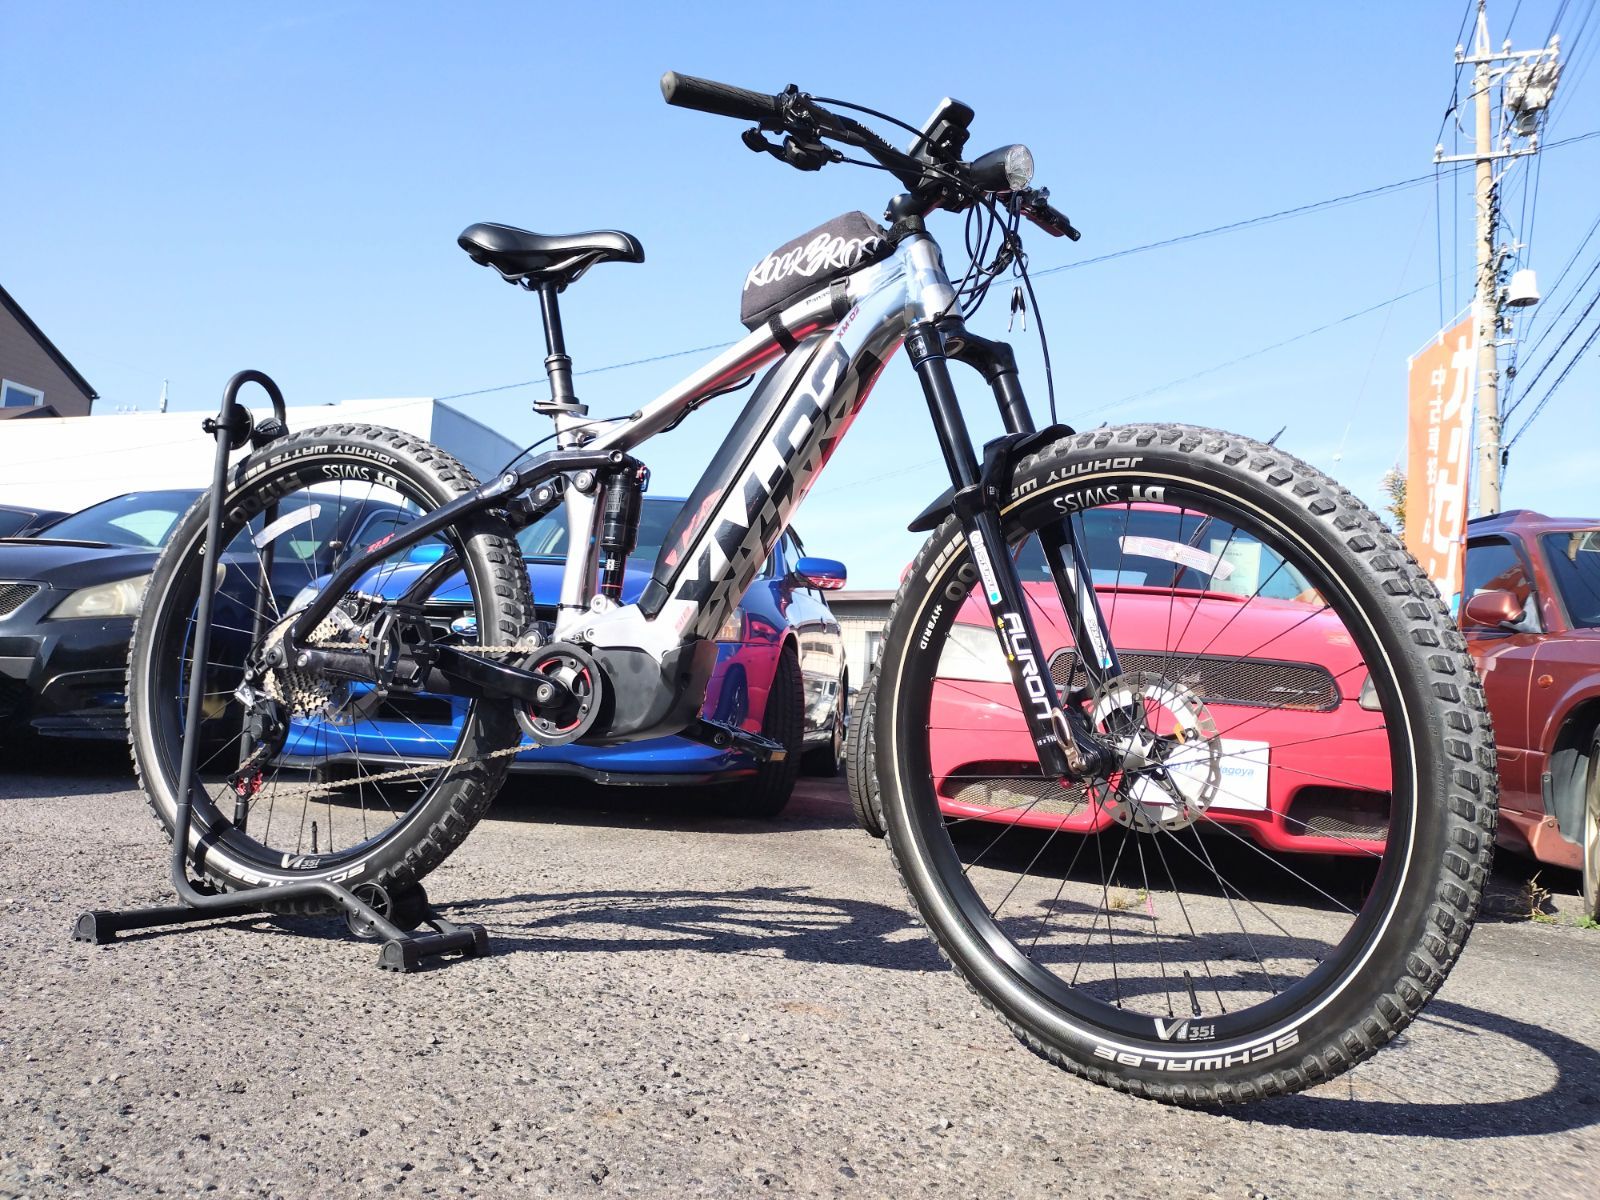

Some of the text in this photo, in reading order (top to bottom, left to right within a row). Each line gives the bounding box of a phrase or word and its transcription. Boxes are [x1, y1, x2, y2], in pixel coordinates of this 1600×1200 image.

[805, 290, 831, 306] Panas
[270, 445, 398, 467] JOHNNY WATTS
[322, 464, 398, 491] DT SWISS
[1046, 457, 1144, 484] JOHNNY
[1053, 485, 1120, 514] SWISS
[1128, 485, 1166, 502] DT
[920, 604, 943, 650] HYBRID
[1003, 612, 1053, 720] AURON
[1219, 765, 1255, 777] agoya
[1094, 1030, 1300, 1071] SCHWALBE
